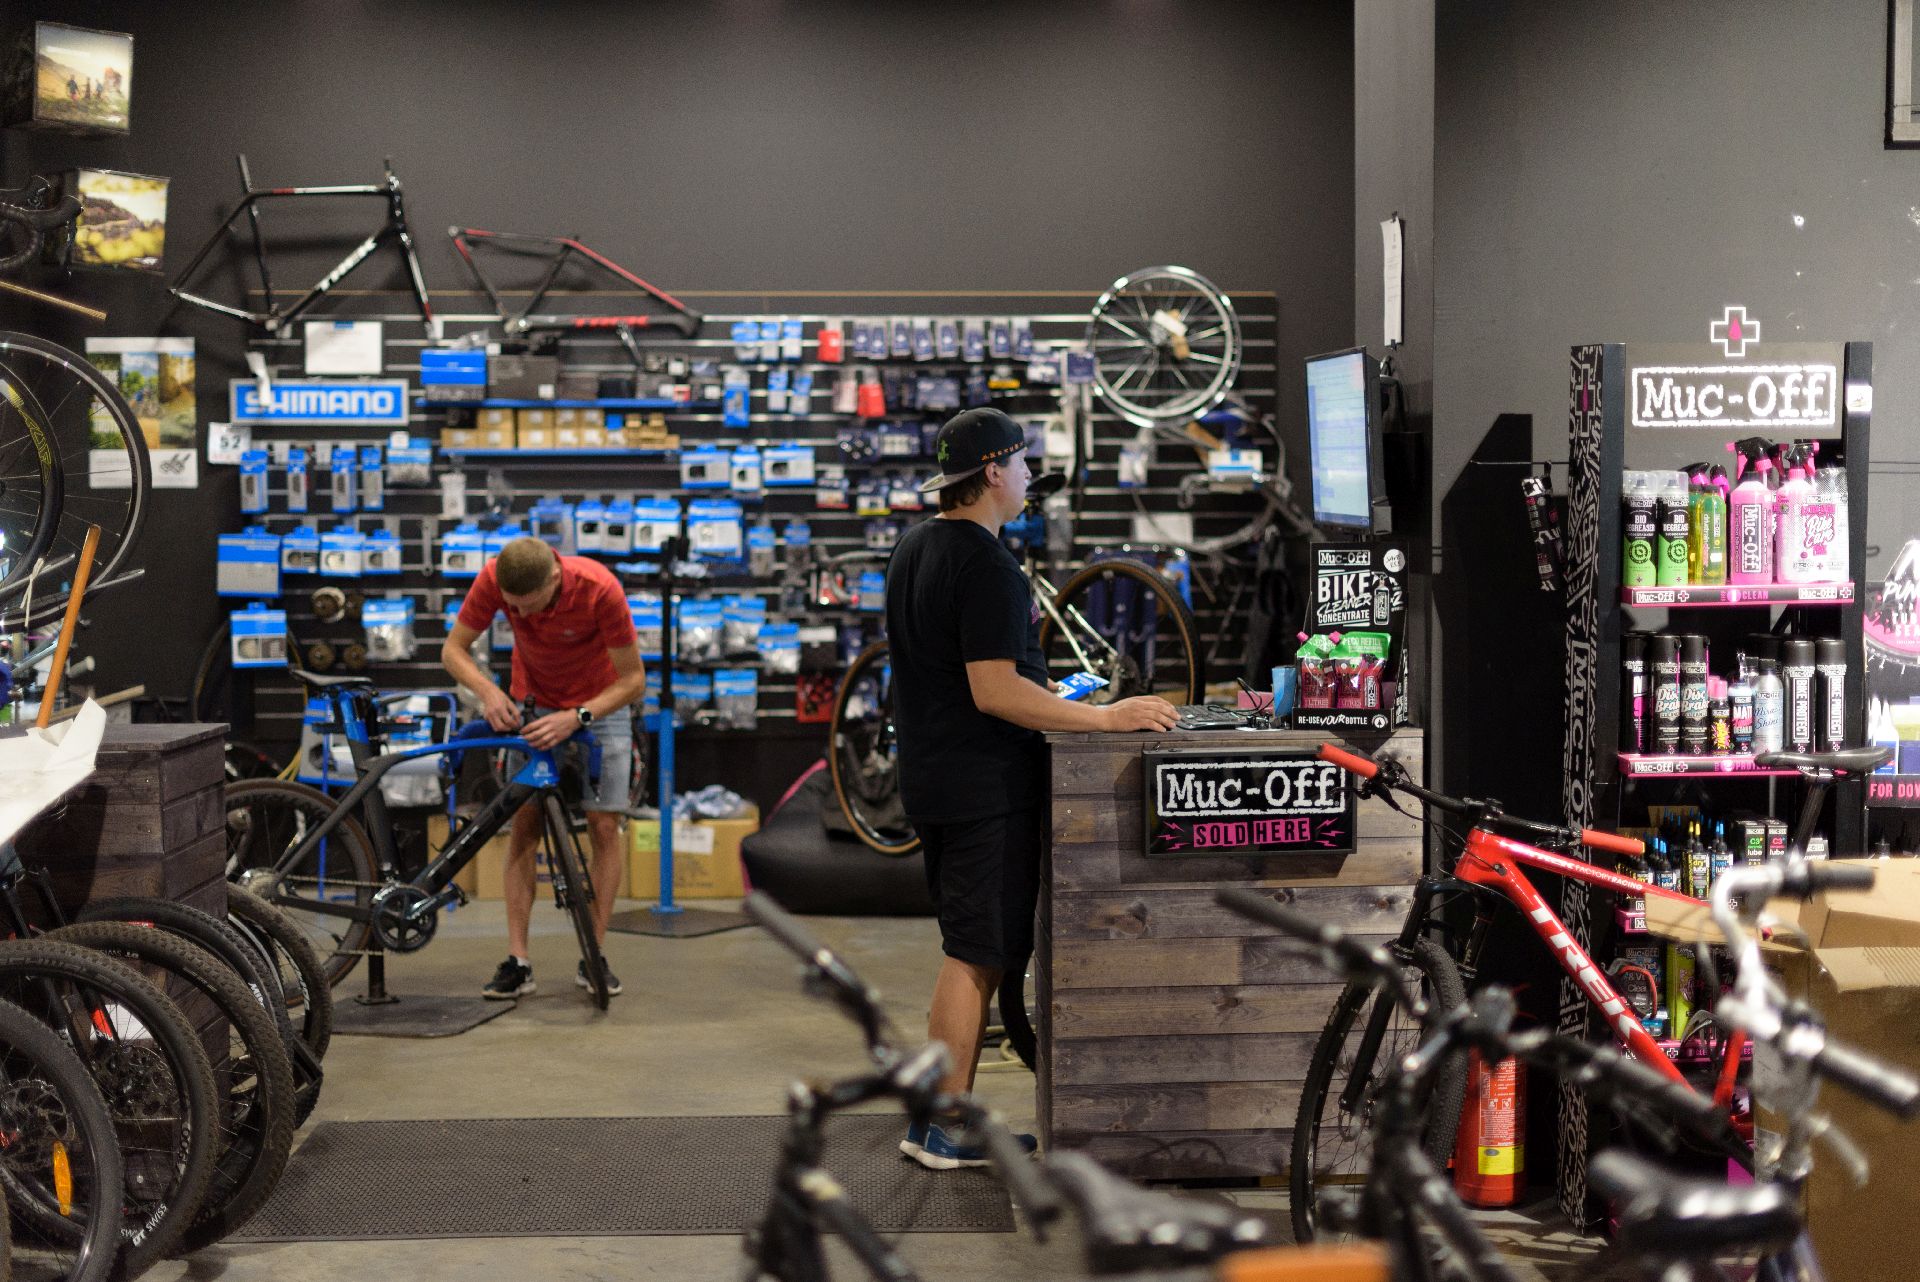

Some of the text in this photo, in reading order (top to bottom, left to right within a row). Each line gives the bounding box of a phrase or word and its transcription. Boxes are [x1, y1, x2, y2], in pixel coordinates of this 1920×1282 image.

[245, 390, 395, 415] SHIMANO
[1641, 373, 1829, 418] Muc-Off
[1743, 507, 1759, 571] Muc-Off
[1320, 552, 1368, 564] Muc-Off
[1318, 572, 1370, 603] BIKE
[1638, 594, 1674, 602] Muc-Off
[1742, 591, 1768, 600] CLEAN
[1317, 592, 1372, 616] CLEANER
[1318, 610, 1370, 624] CONCENTRATE
[1895, 624, 1920, 637] SEA
[1682, 688, 1706, 700] Disc
[1796, 679, 1808, 699] BIKE
[1298, 716, 1320, 724] RE-USE
[1345, 716, 1368, 725] BOTTLE
[1796, 700, 1808, 736] PROTECT
[1636, 762, 1673, 772] Muc-Off
[1166, 767, 1340, 809] Muc-Off
[1869, 783, 1893, 797] FOR
[1195, 819, 1309, 846] SOLD HERE
[1575, 864, 1612, 882] FACTORY
[1611, 877, 1643, 891] RACING
[1530, 894, 1644, 1039] TREK
[145, 1203, 168, 1232] SWISS
